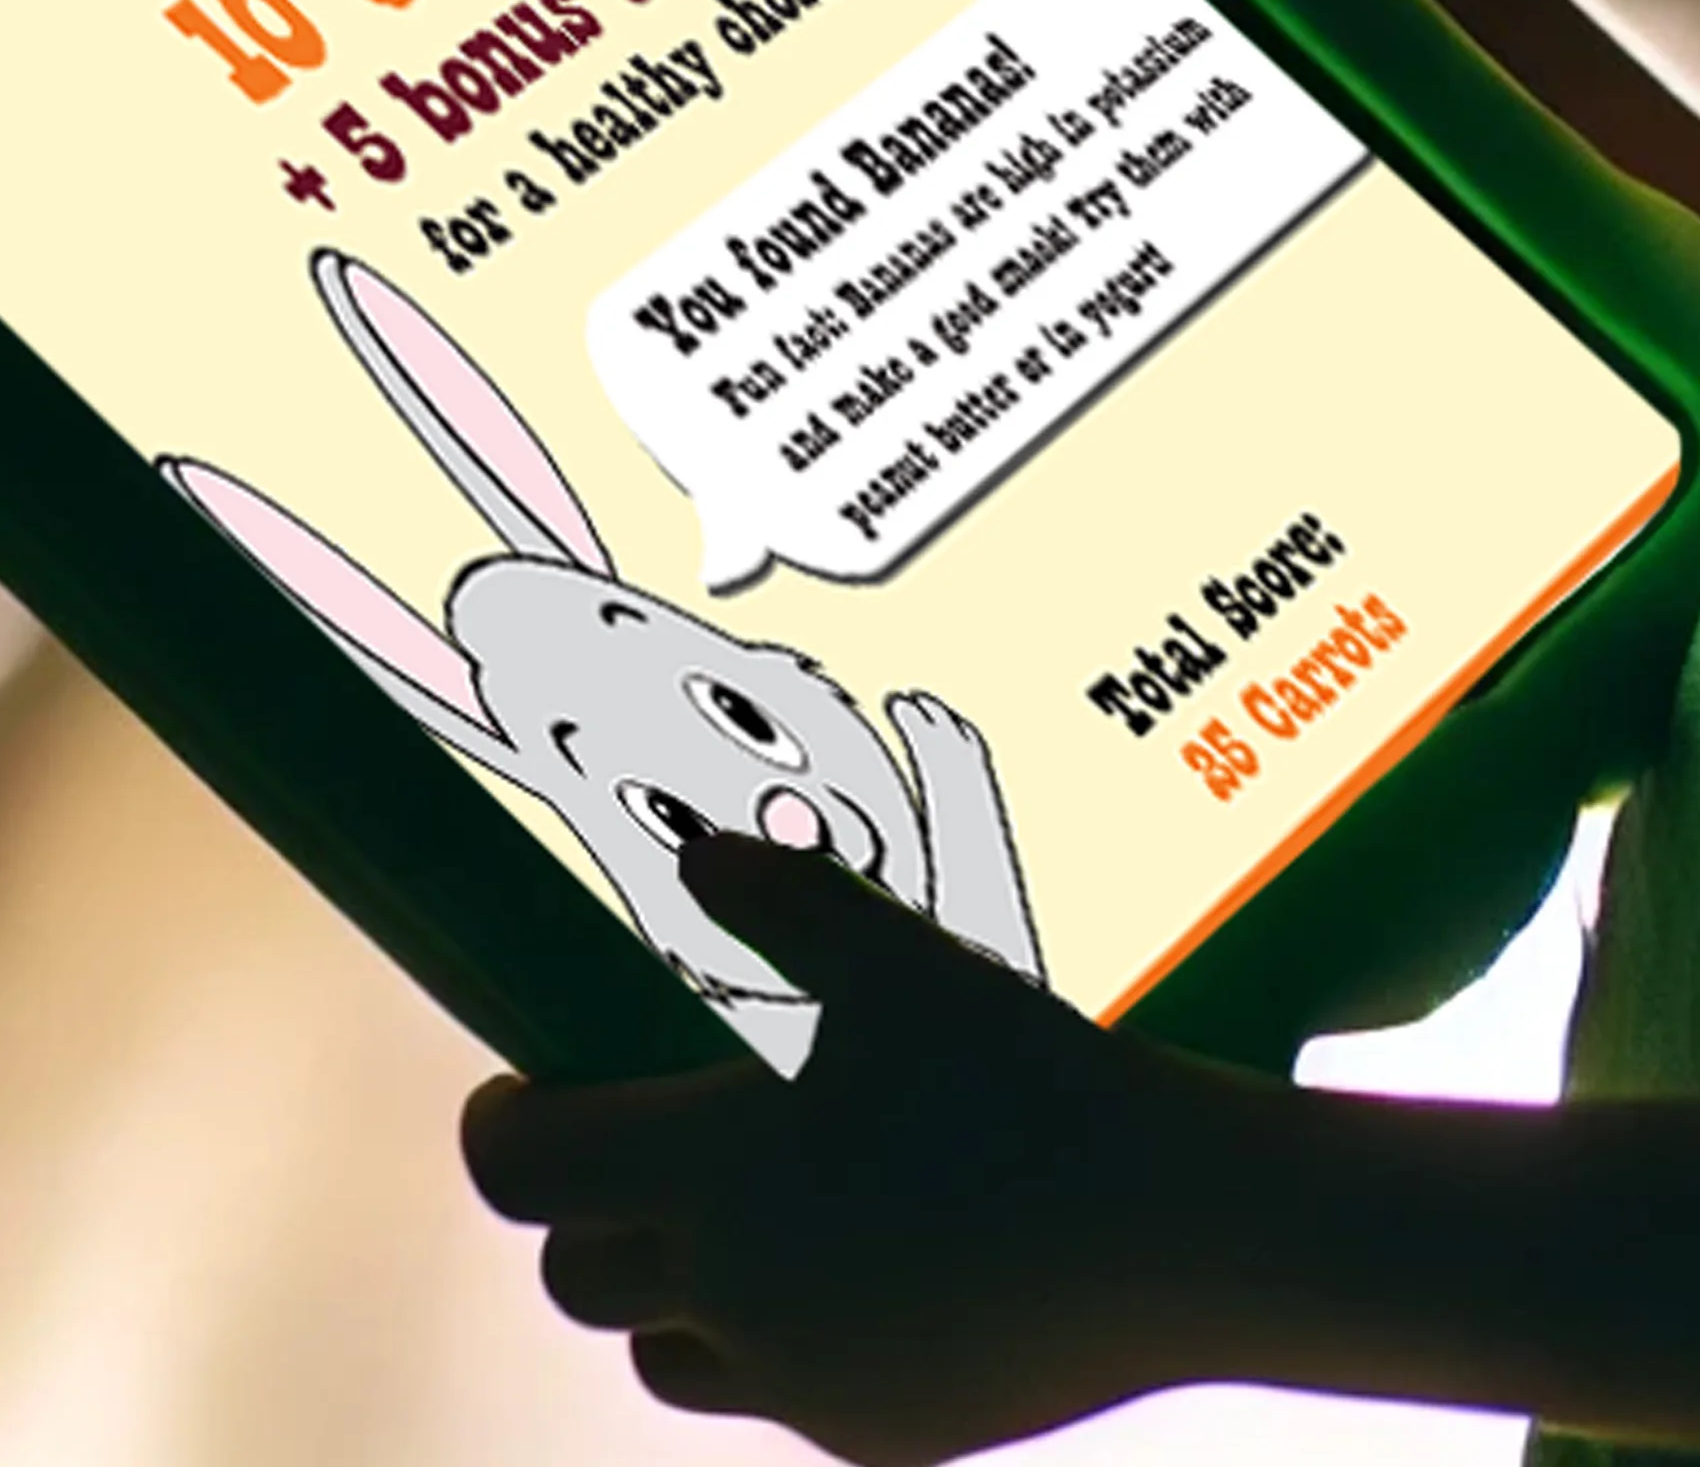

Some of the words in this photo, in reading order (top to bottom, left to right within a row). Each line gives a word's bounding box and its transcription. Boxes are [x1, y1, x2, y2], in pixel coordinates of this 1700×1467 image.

[278, 158, 336, 212] +
[323, 101, 406, 183] 5
[503, 169, 557, 215] a
[528, 39, 724, 187] healthy
[632, 276, 749, 358] You
[725, 169, 867, 292] found
[840, 32, 1037, 197] Bananas!
[709, 360, 787, 419] Fun
[772, 306, 851, 373] fact:
[834, 217, 956, 320] Bananas
[950, 183, 1003, 231] are
[984, 131, 1065, 194] high
[1046, 106, 1096, 147] in
[1087, 16, 1213, 128] potassium
[420, 196, 513, 274] for
[779, 411, 841, 473] and
[830, 354, 916, 427] make
[906, 336, 939, 366] a
[930, 280, 1000, 355] good
[1065, 179, 1131, 229] Try
[1115, 127, 1193, 188] them
[1182, 75, 1253, 135] with
[838, 438, 940, 542] peanut
[923, 370, 1021, 454] butter
[1014, 345, 1054, 384] or
[1037, 321, 1088, 358] in
[1085, 612, 1227, 738] Total
[1200, 512, 1346, 641] Score:
[1180, 717, 1260, 803] 25
[1238, 593, 1408, 740] Carrots
